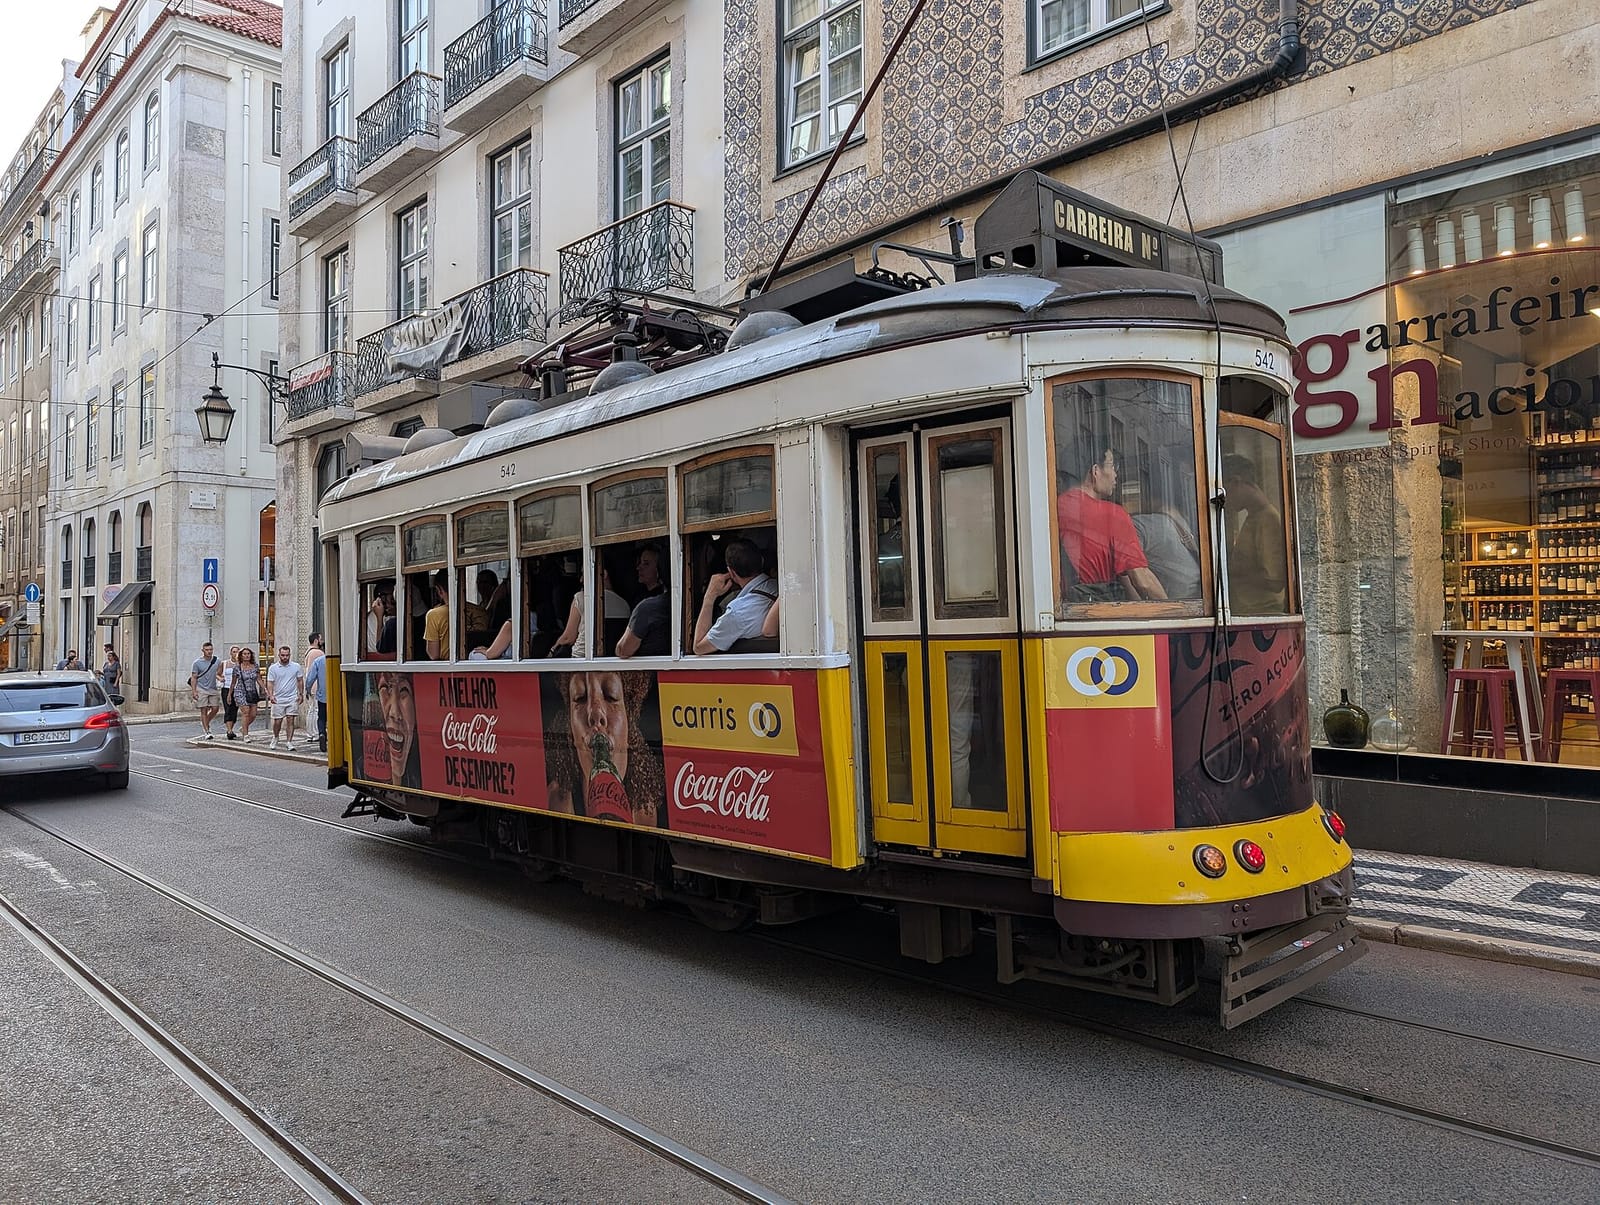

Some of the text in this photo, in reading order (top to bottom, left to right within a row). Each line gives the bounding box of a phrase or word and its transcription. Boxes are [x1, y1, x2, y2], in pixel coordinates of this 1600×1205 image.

[1054, 198, 1134, 254] CARREIRA
[1254, 348, 1275, 371] 542
[500, 463, 516, 478] 542
[1332, 451, 1373, 465] Wine
[1380, 447, 1391, 459] &
[1399, 442, 1460, 461] Spirits
[439, 676, 498, 709] A MELHOR
[1218, 679, 1263, 722] ZERO
[441, 711, 499, 754] Coca-Cola
[671, 696, 737, 732] carris
[445, 755, 516, 796] DE SEMPRE?
[673, 760, 775, 823] Coca-Cola
